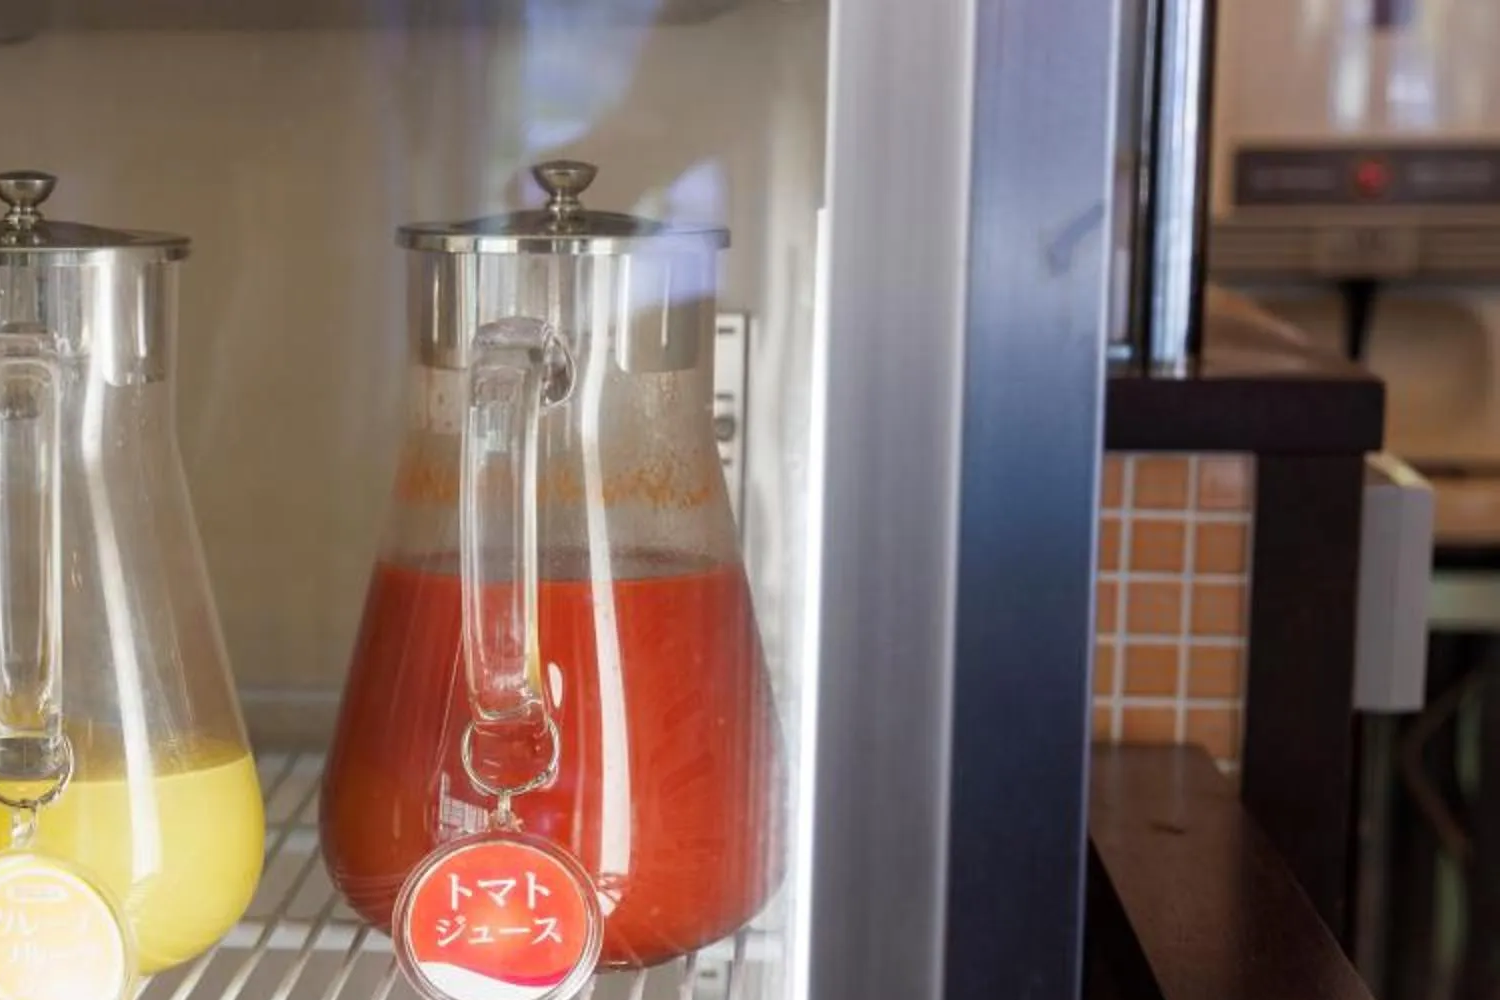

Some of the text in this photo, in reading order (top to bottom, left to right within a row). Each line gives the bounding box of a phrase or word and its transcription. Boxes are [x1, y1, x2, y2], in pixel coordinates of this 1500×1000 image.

[447, 871, 551, 911] トマト
[435, 915, 563, 947] ジュース
